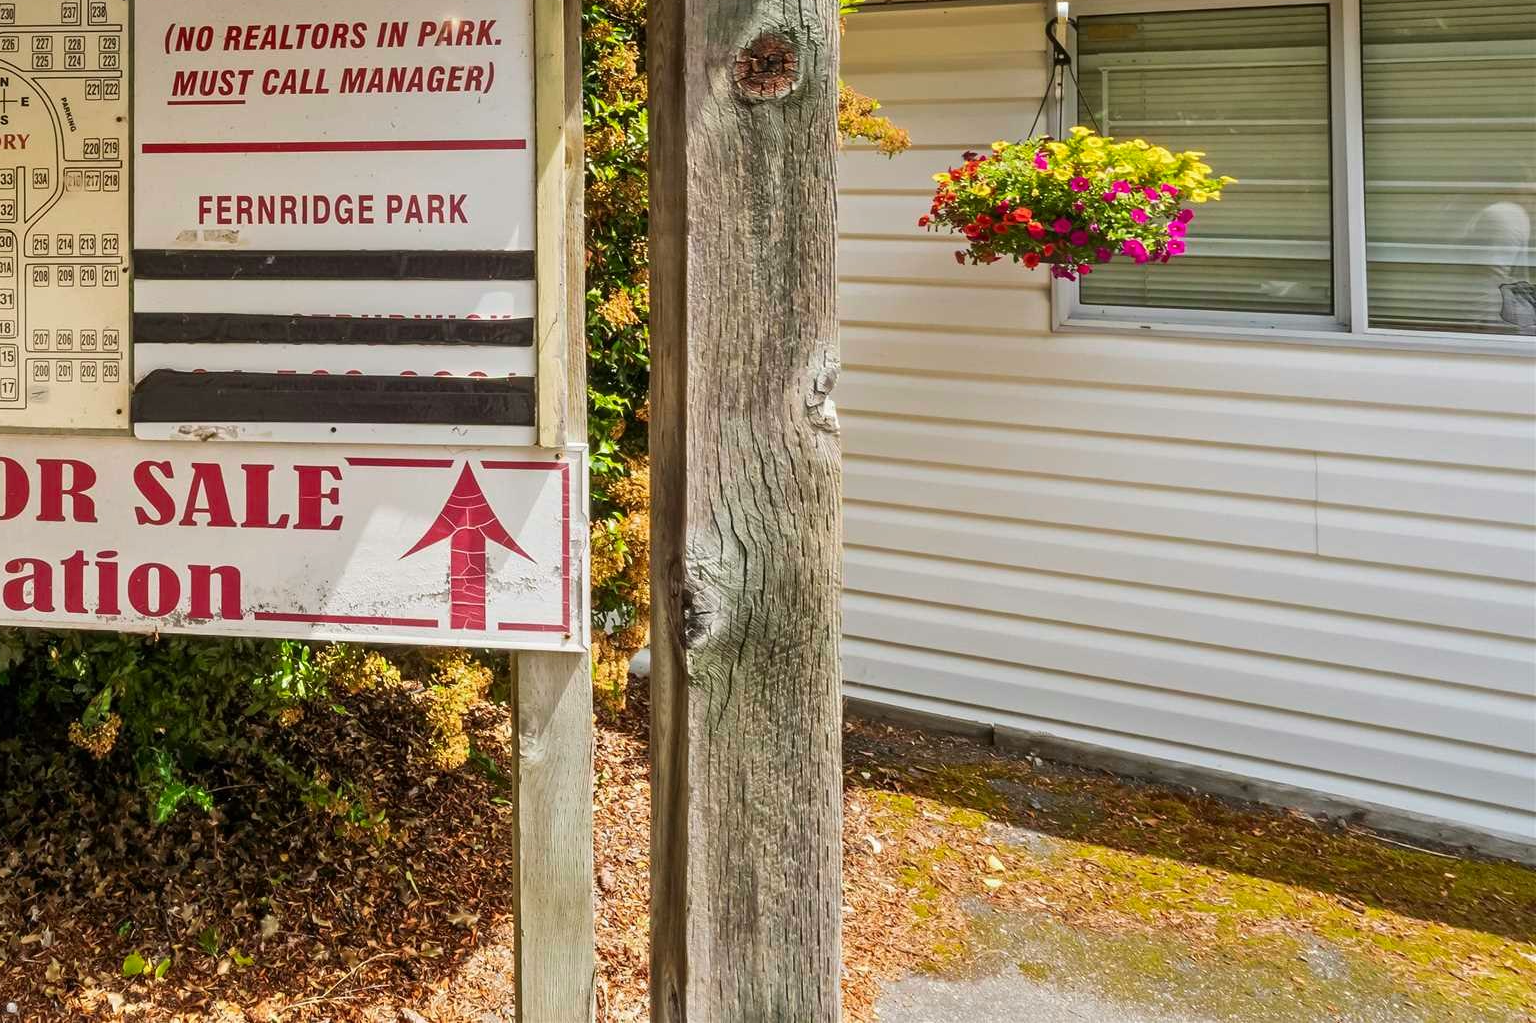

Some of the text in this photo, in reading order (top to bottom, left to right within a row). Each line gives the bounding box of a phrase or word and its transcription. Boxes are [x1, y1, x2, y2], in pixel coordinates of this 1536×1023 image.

[1, 8, 14, 19] 230
[165, 20, 502, 54] (NO REALTORS IN PARK.
[36, 38, 49, 49] 227
[36, 56, 48, 67] 225
[103, 55, 116, 66] 223
[0, 78, 8, 87] N
[171, 62, 495, 96] MUST CALL MANAGER)
[87, 84, 100, 95] 221
[21, 97, 29, 106] E
[0, 115, 8, 125] S
[61, 97, 77, 132] PARKING
[104, 142, 117, 154] 219
[0, 174, 13, 185] 33
[34, 173, 47, 184] 33A
[105, 175, 117, 186] 218
[1, 204, 13, 216] 32
[199, 193, 468, 225] FERNRIDGE PARK
[0, 236, 11, 247] 30
[34, 239, 48, 250] 215
[81, 238, 94, 250] 213
[0, 263, 11, 273] 31A
[35, 271, 48, 282] 208
[81, 270, 94, 281] 210
[0, 294, 12, 305] 31
[35, 334, 48, 345] 207
[81, 334, 95, 345] 205
[2, 351, 14, 362] 15
[35, 366, 48, 377] 200
[82, 366, 95, 377] 202
[3, 383, 14, 393] 17
[134, 461, 344, 533] SALE
